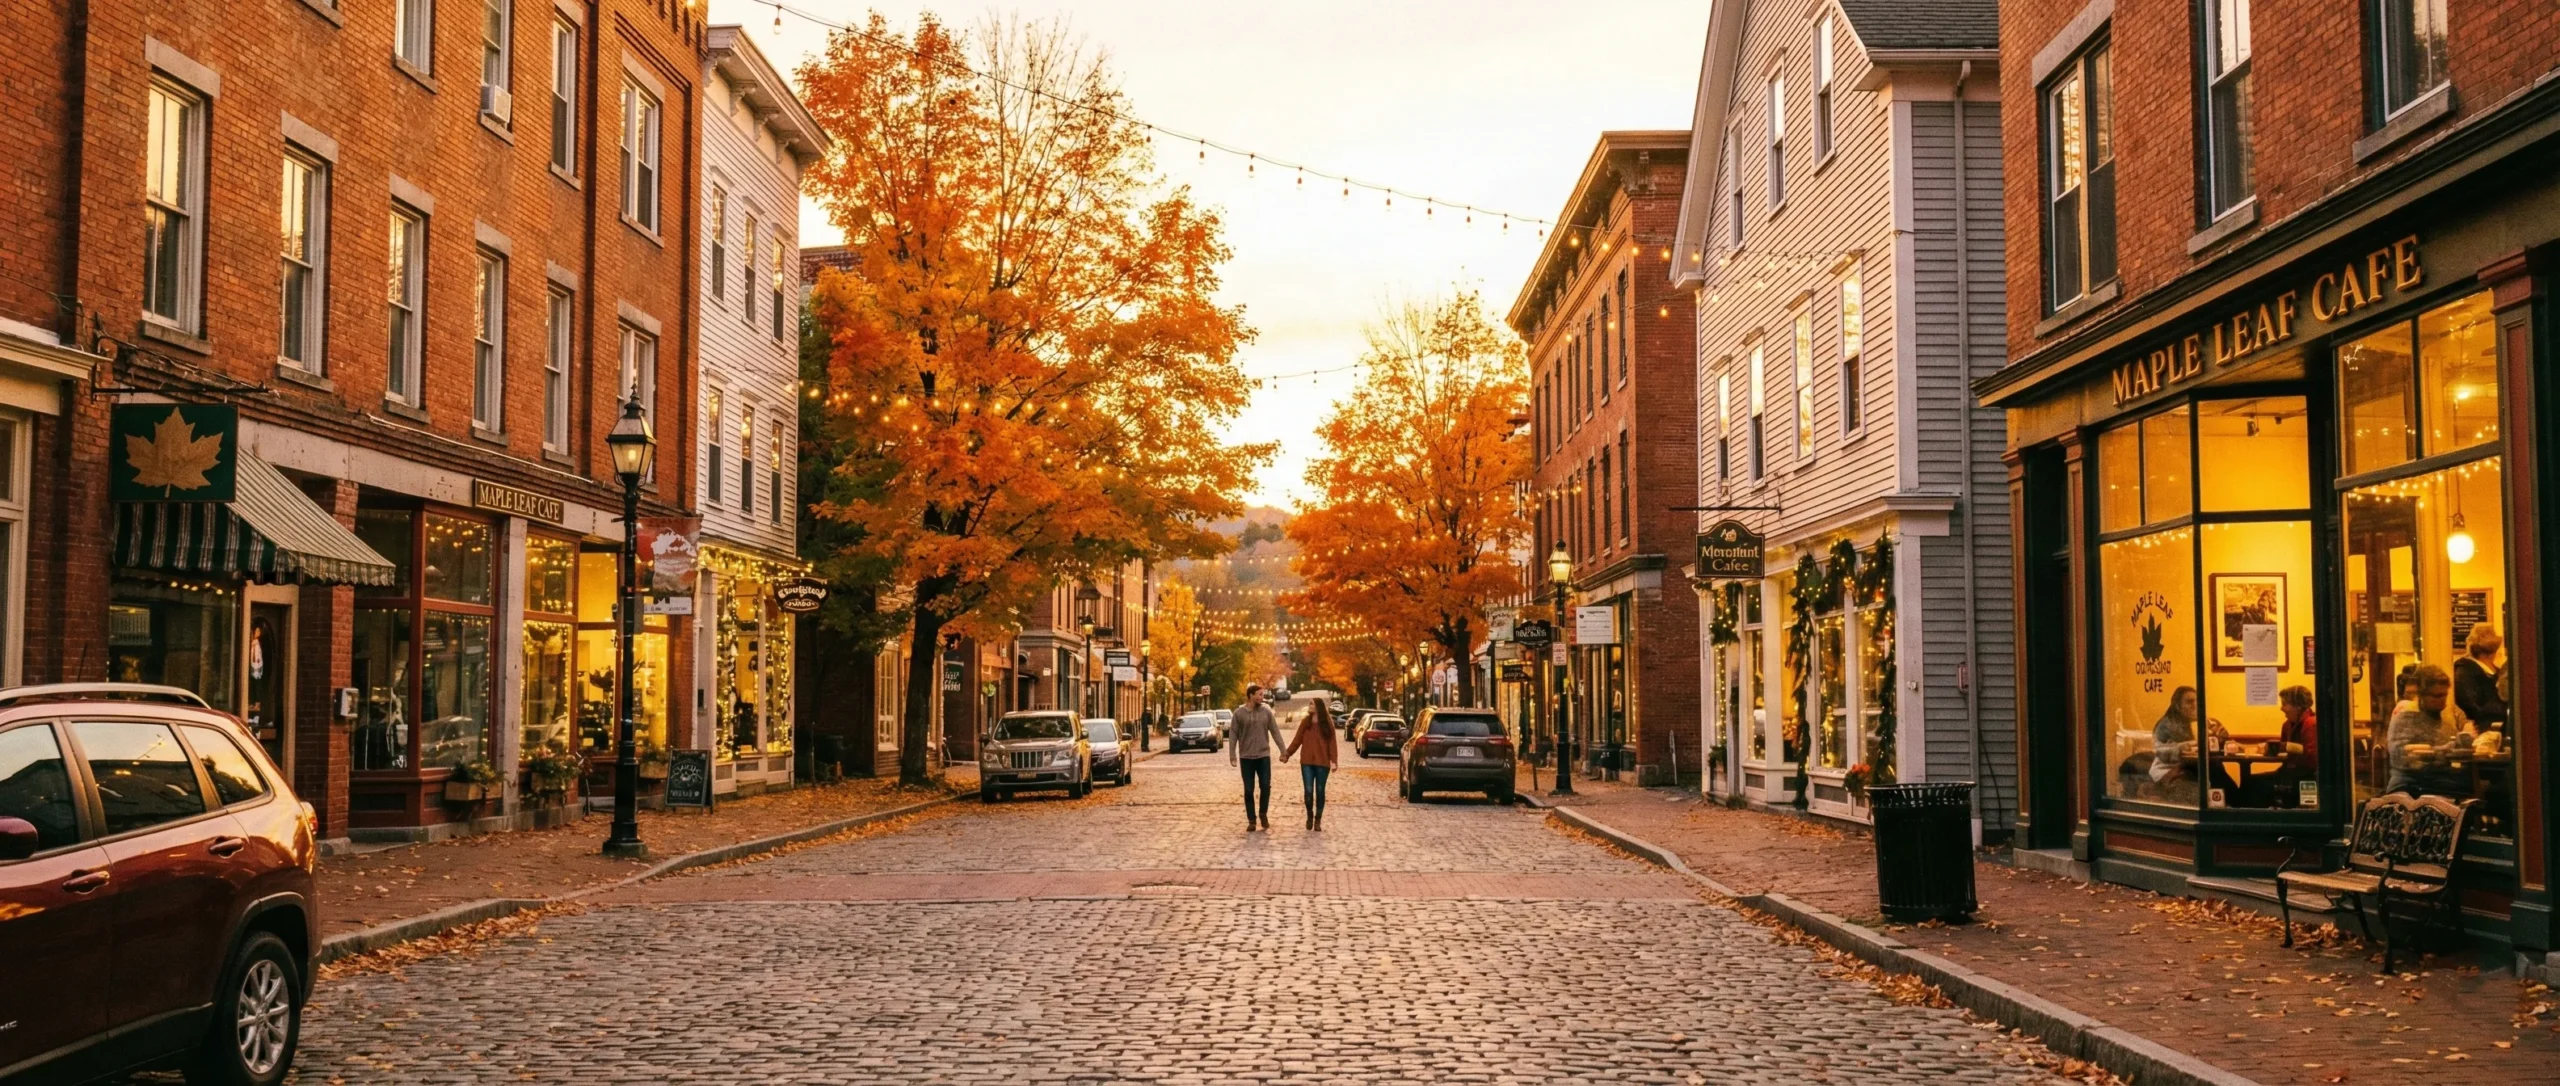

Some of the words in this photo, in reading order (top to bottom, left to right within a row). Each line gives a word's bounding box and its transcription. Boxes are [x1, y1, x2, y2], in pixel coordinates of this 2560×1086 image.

[2112, 333, 2202, 407] MAPLE
[2213, 289, 2297, 367] LEAF
[2312, 234, 2421, 322] CAFE
[480, 484, 512, 509] MAPLE
[514, 492, 537, 515] LEAF
[538, 498, 560, 521] CAFE
[2131, 591, 2153, 628] MAPLE
[2156, 591, 2174, 620] LEAF
[2144, 678, 2163, 693] CAFE
